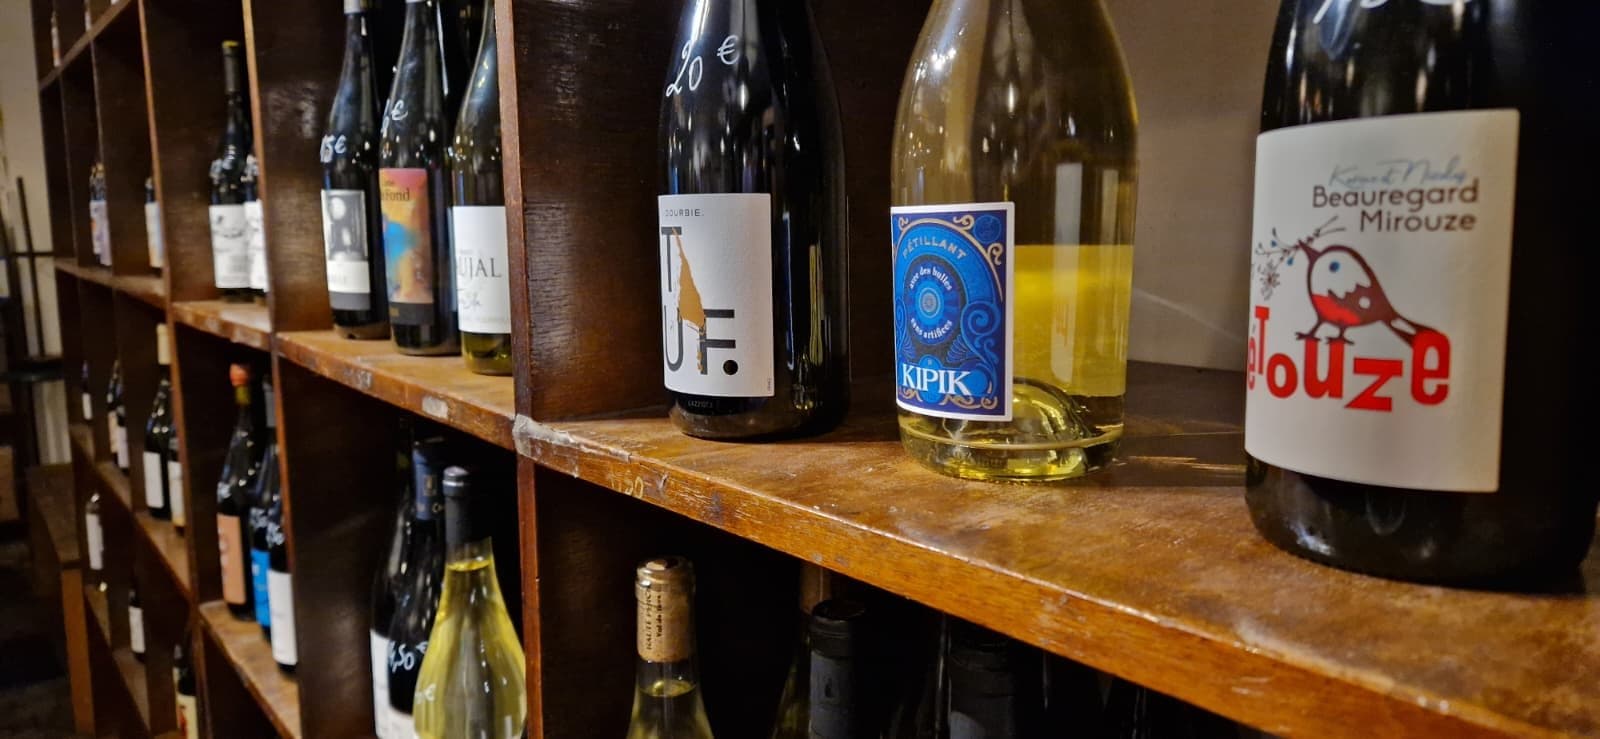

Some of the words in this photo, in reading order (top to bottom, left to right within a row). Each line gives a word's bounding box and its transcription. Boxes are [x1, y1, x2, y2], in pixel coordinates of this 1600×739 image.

[664, 39, 702, 97] 20
[717, 34, 741, 66] €
[1312, 177, 1480, 213] Beauregard
[1359, 209, 1477, 232] Mirouze
[902, 235, 968, 260] PÉTILLANT
[919, 265, 931, 276] des
[931, 265, 953, 291] bulles
[910, 317, 923, 336] sans
[923, 319, 953, 339] artifices
[901, 362, 972, 397] KIPIK
